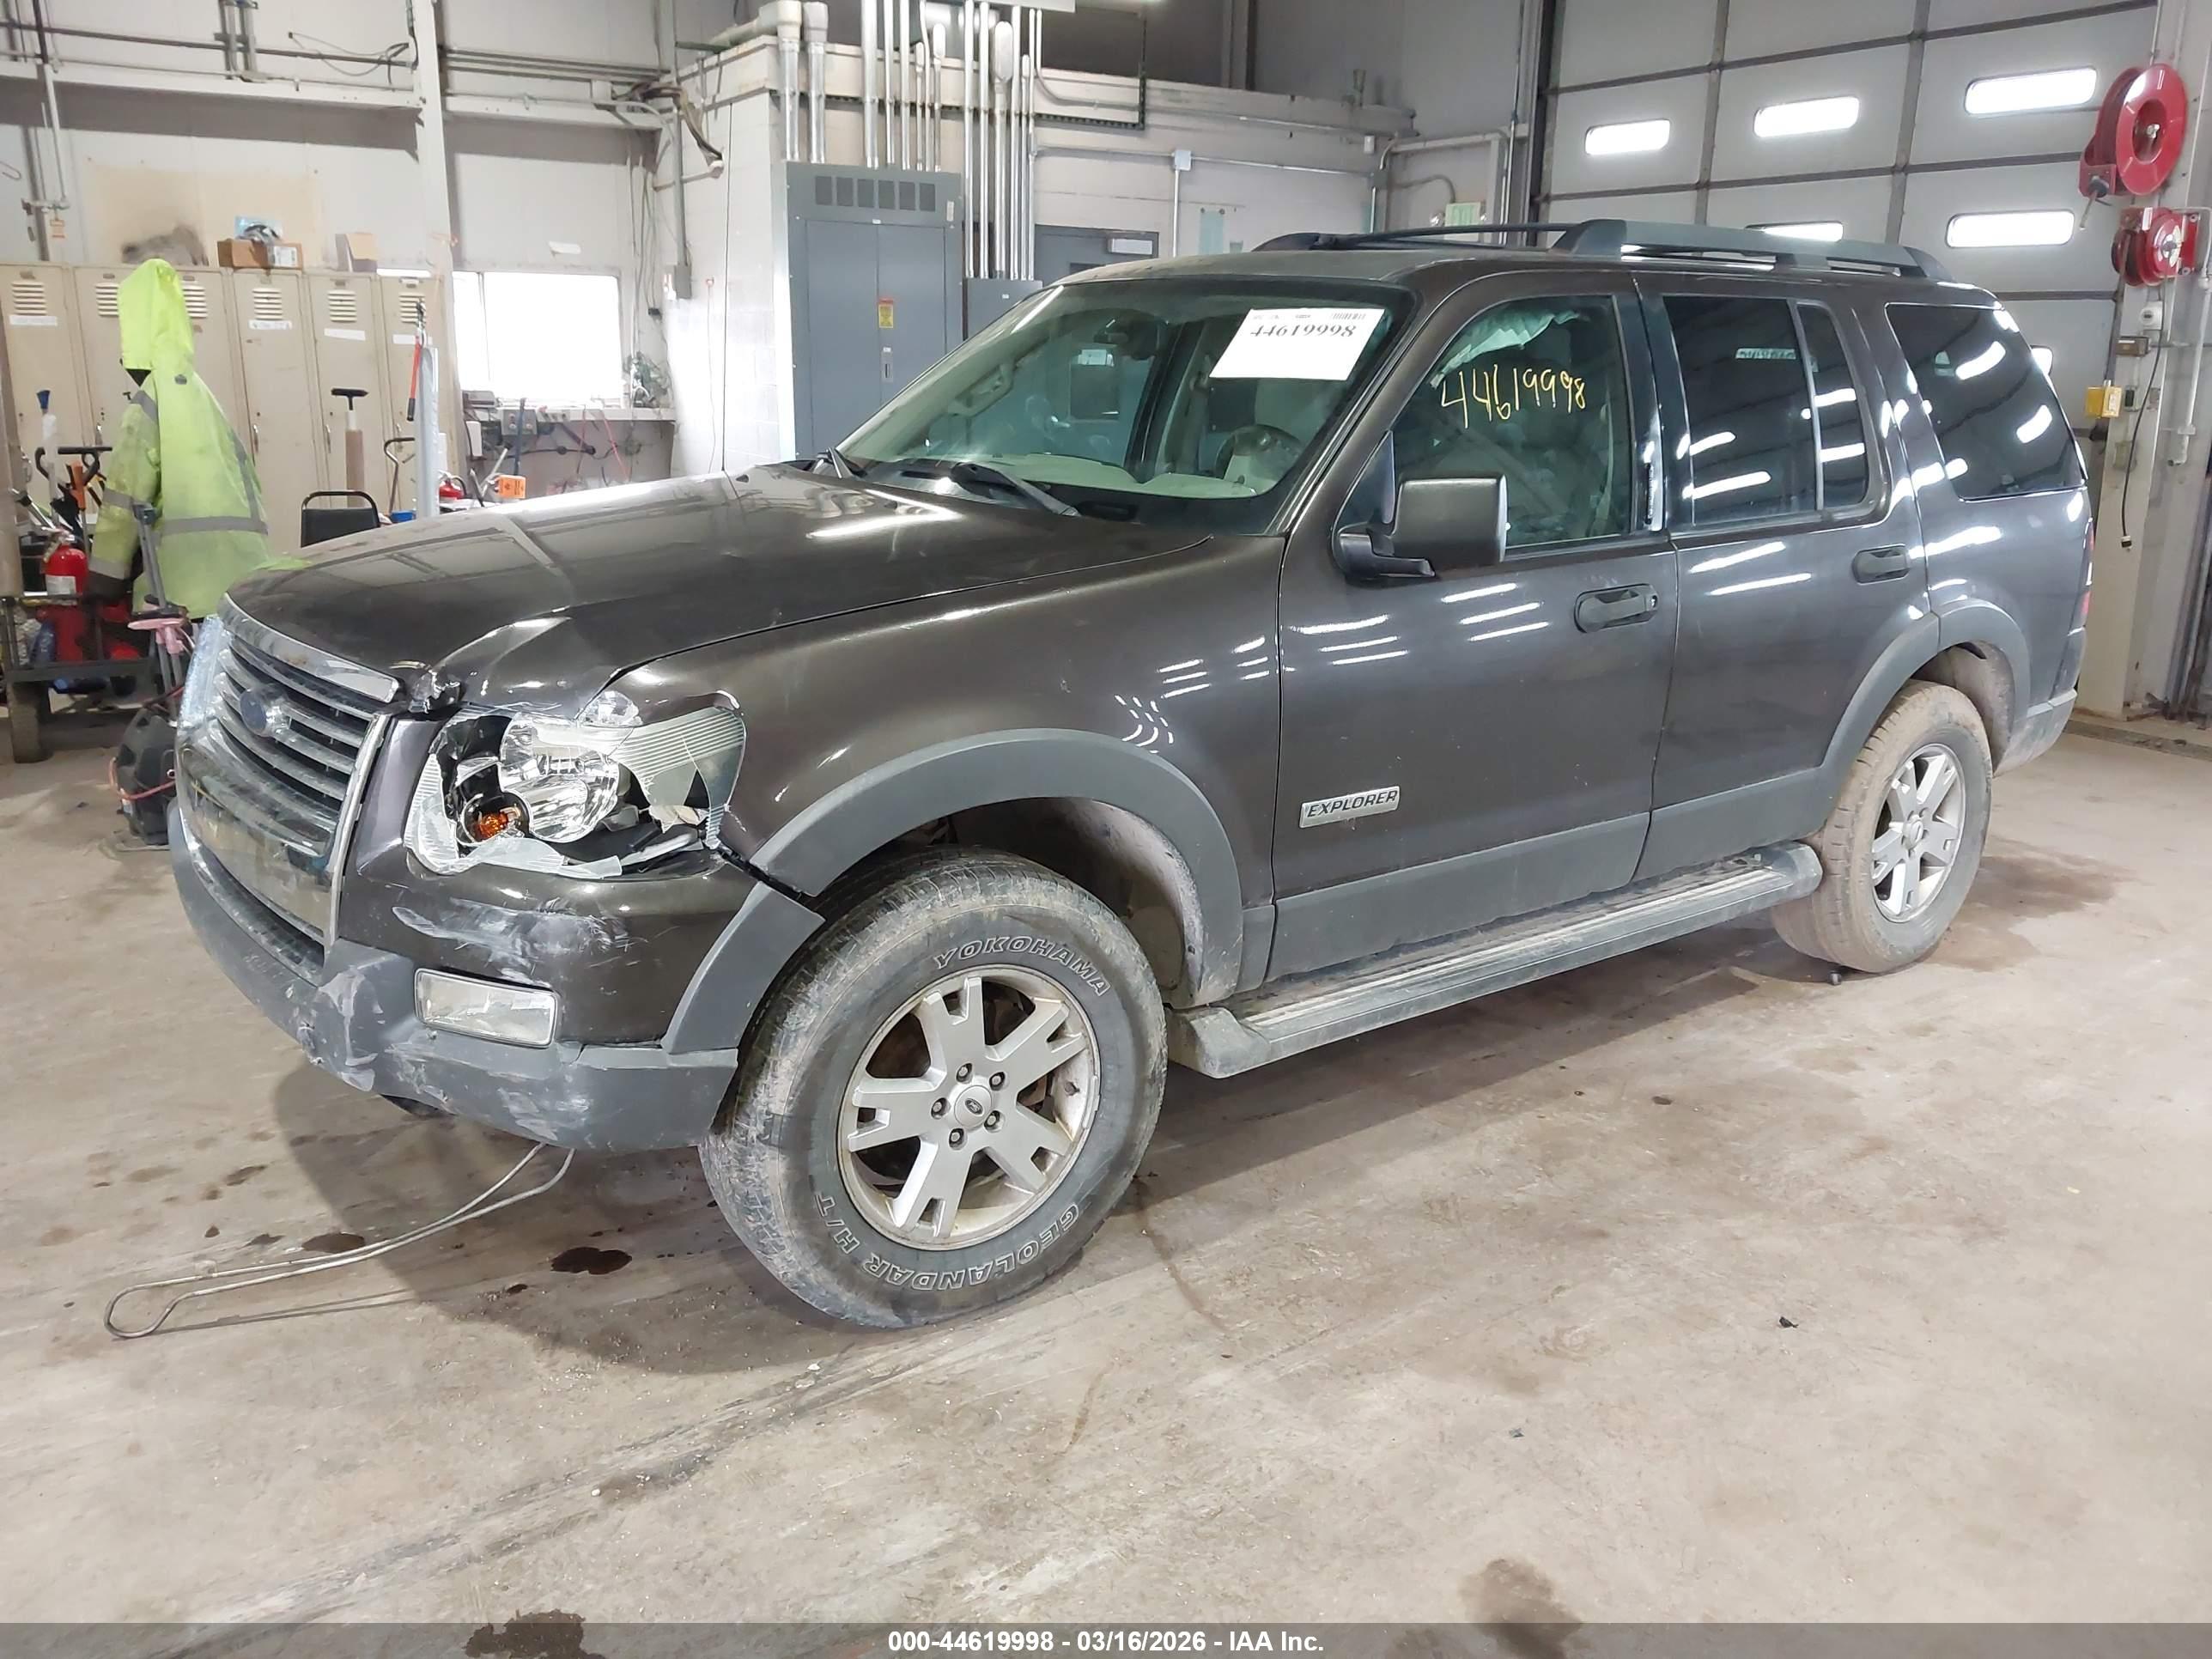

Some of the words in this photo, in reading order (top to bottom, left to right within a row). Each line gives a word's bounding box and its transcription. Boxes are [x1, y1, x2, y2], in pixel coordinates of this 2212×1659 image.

[1250, 324, 1357, 337] 44619998
[1441, 363, 1586, 429] 44619998
[1307, 790, 1399, 818] EXPLORER
[933, 935, 1112, 997] YOKOHAMA
[815, 1191, 860, 1255] H/T
[861, 1203, 1079, 1291] GEOLANDAR
